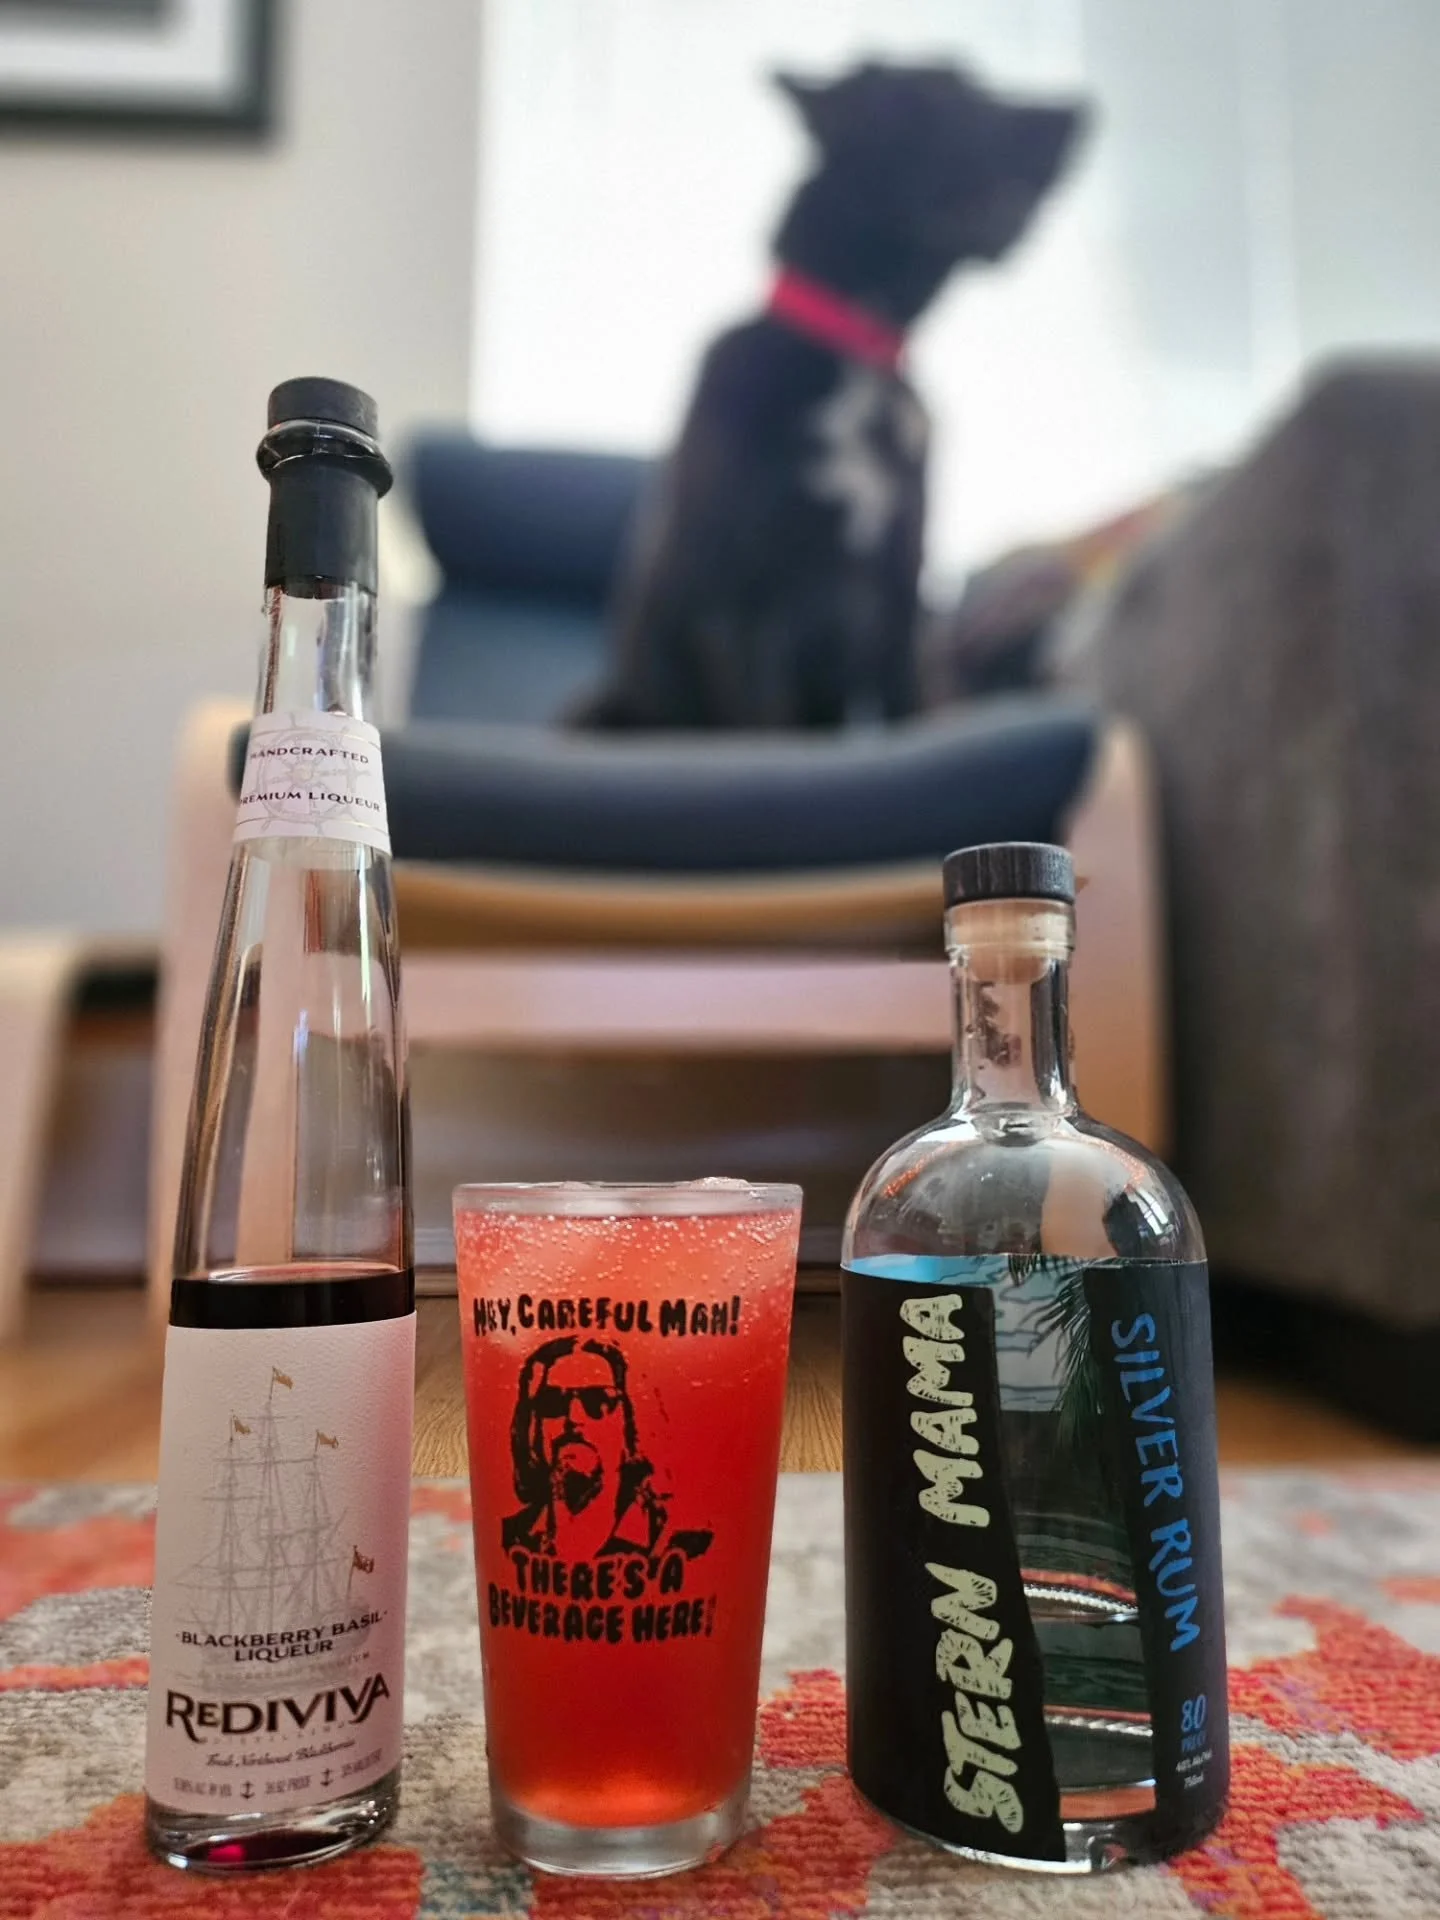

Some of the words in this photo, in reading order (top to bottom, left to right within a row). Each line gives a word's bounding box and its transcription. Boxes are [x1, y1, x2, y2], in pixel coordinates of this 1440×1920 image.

[250, 746, 369, 764] HANDCRAFTED
[308, 792, 380, 812] LIQUEUR
[517, 1293, 653, 1332] CAREFUL
[659, 1295, 740, 1337] MAN!
[900, 1293, 990, 1528] MAMA
[1111, 1311, 1184, 1507] SILVER
[1148, 1517, 1202, 1652] RUM
[511, 1550, 645, 1601] THERE'S
[659, 1552, 684, 1595] A
[488, 1582, 623, 1643] BEVERAGE
[632, 1595, 717, 1643] HERE!
[234, 1639, 334, 1663] LIQUEUR
[925, 1562, 1022, 1833] STERN
[1181, 1693, 1206, 1732] 80
